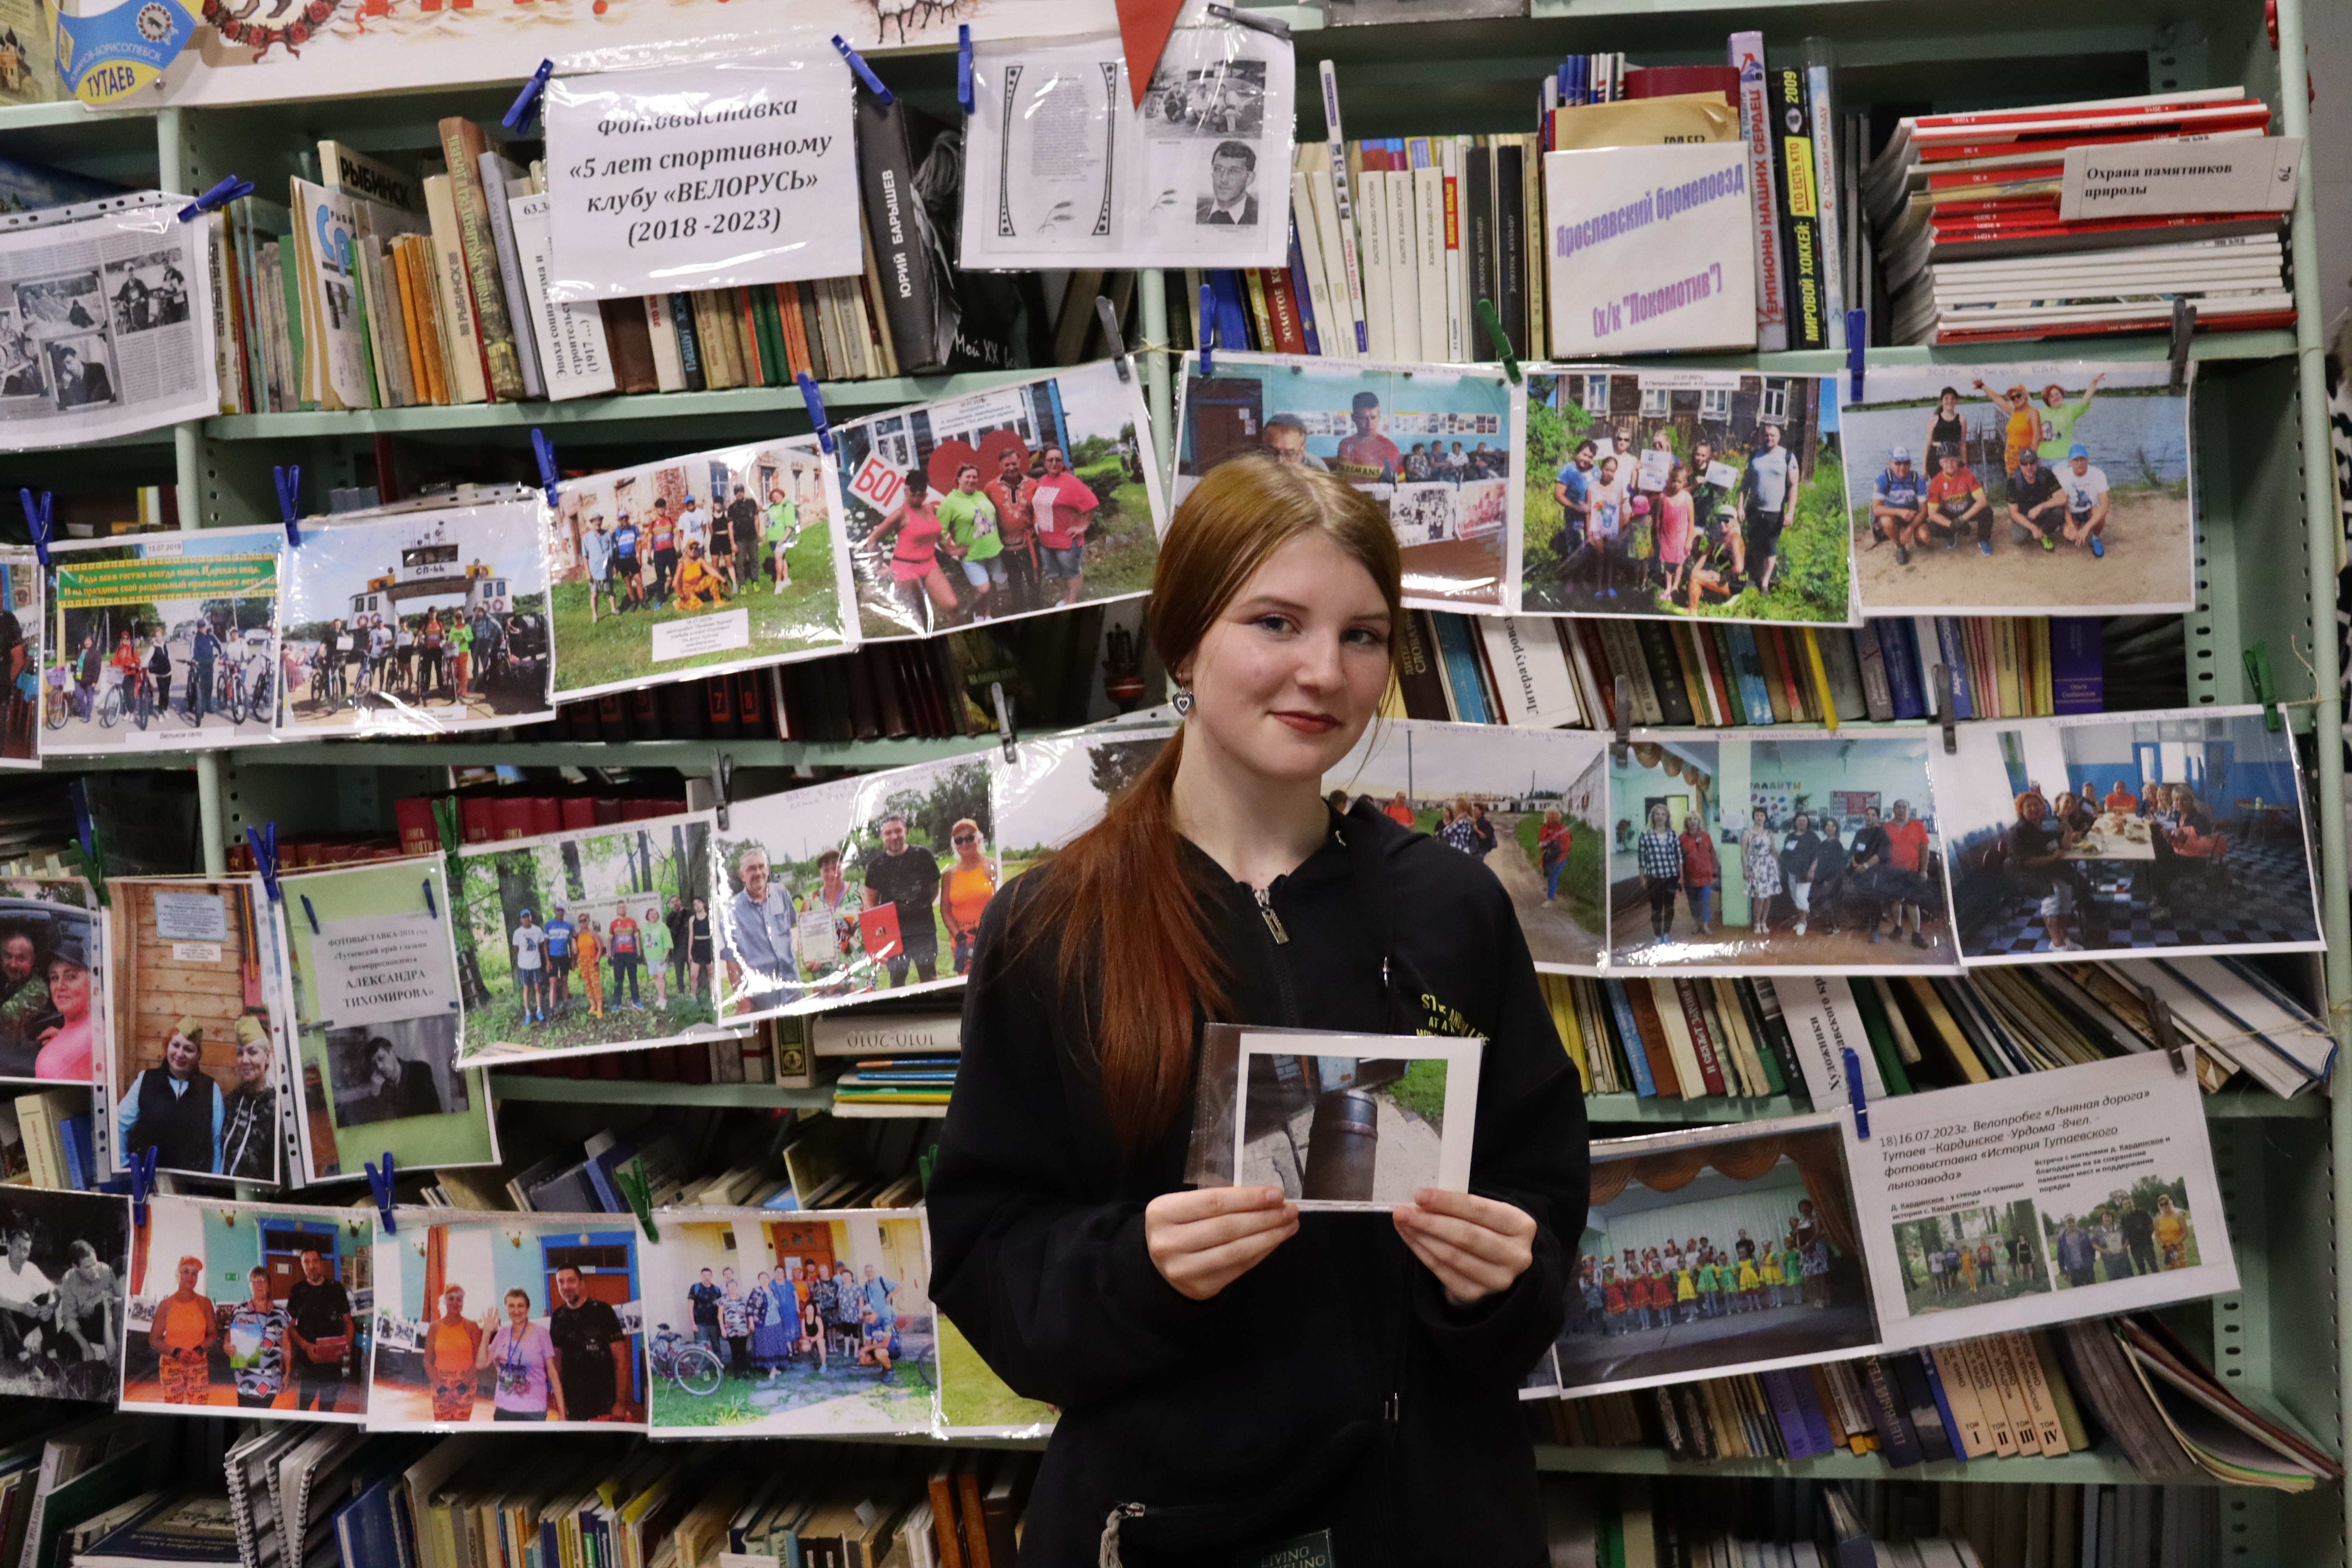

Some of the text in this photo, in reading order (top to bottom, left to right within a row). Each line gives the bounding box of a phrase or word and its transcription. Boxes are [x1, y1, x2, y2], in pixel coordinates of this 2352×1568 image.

[87, 67, 135, 97] ТУТАЕВ
[1786, 71, 1798, 104] 2009
[1751, 89, 1766, 154] СЕРДЕЦ
[569, 134, 833, 179] «5 лет спортивному
[340, 157, 412, 209] РЫБИНСК
[1789, 142, 1804, 213] КТО ЕСТЬ КТО
[1822, 148, 1834, 196] Стрижи
[2087, 164, 2232, 181] Охрана памятников
[2278, 166, 2292, 183] 79
[587, 169, 818, 215] клубу «ВЕЛОРУСЬ»
[1754, 160, 1772, 225] НАШИХ
[2085, 185, 2147, 200] природы
[1556, 163, 1744, 258] Ярославский бронепоезд
[627, 207, 782, 248] (2018 -2023)
[882, 169, 912, 298] ЮРИЙ БАРЫШЕВ
[450, 266, 469, 322] РЫБИНСК
[1271, 266, 1294, 343] ЗОЛОТОЕ КО
[1622, 262, 1722, 325] "Локомотив")
[1803, 277, 1819, 342] МИРОВОЙ
[551, 340, 567, 379] Эпоха
[583, 341, 600, 372] (1917
[713, 692, 724, 709] 7
[567, 904, 595, 912] Страницы
[380, 945, 397, 954] край
[399, 942, 427, 951] глазами
[346, 970, 426, 989] АЛЕКСАНДРА
[342, 988, 434, 1008] ТИХОМИРОВА»
[848, 1030, 934, 1048] 1010-2010
[1809, 1016, 1842, 1092] Художники
[1973, 1112, 2042, 1132] Велопробег
[2045, 1099, 2100, 1117] «Льняная
[2102, 1090, 2151, 1107] дорога»
[1882, 1147, 1926, 1162] Тутаев
[1884, 1126, 2118, 1178] фотовыставка «История Тутаевского
[2034, 1156, 2063, 1167] Встреча
[2071, 1147, 2109, 1160] жителями
[2119, 1138, 2164, 1150] Кардинское
[2036, 1162, 2081, 1175] благодарим
[2103, 1150, 2146, 1163] сохранение
[1887, 1171, 1962, 1192] льнозавода»
[2038, 1173, 2075, 1184] памятных
[2102, 1158, 2154, 1172] поддержание
[1900, 1196, 1945, 1209] Кардинское
[1956, 1189, 1982, 1200] стенда
[1983, 1182, 2024, 1193] «Страницы
[2039, 1182, 2071, 1193] порядка
[1892, 1210, 1923, 1221] истории
[1931, 1199, 1980, 1213] Кардинское»
[1954, 1362, 1966, 1388] КИНО
[1980, 1363, 1993, 1388] КИНО
[2004, 1362, 2016, 1386] КИНО
[2029, 1362, 2041, 1387] КИНО
[1965, 1421, 1980, 1430] ТОМ
[1991, 1421, 2006, 1430] ТОМ
[2016, 1419, 2030, 1428] ТОМ
[2020, 1429, 2035, 1444] III
[2040, 1420, 2054, 1429] ТОМ
[1973, 1431, 1980, 1445] I
[1997, 1431, 2008, 1445] II
[2044, 1429, 2058, 1445] IV
[29, 1494, 44, 1543] ИВАНОВА
